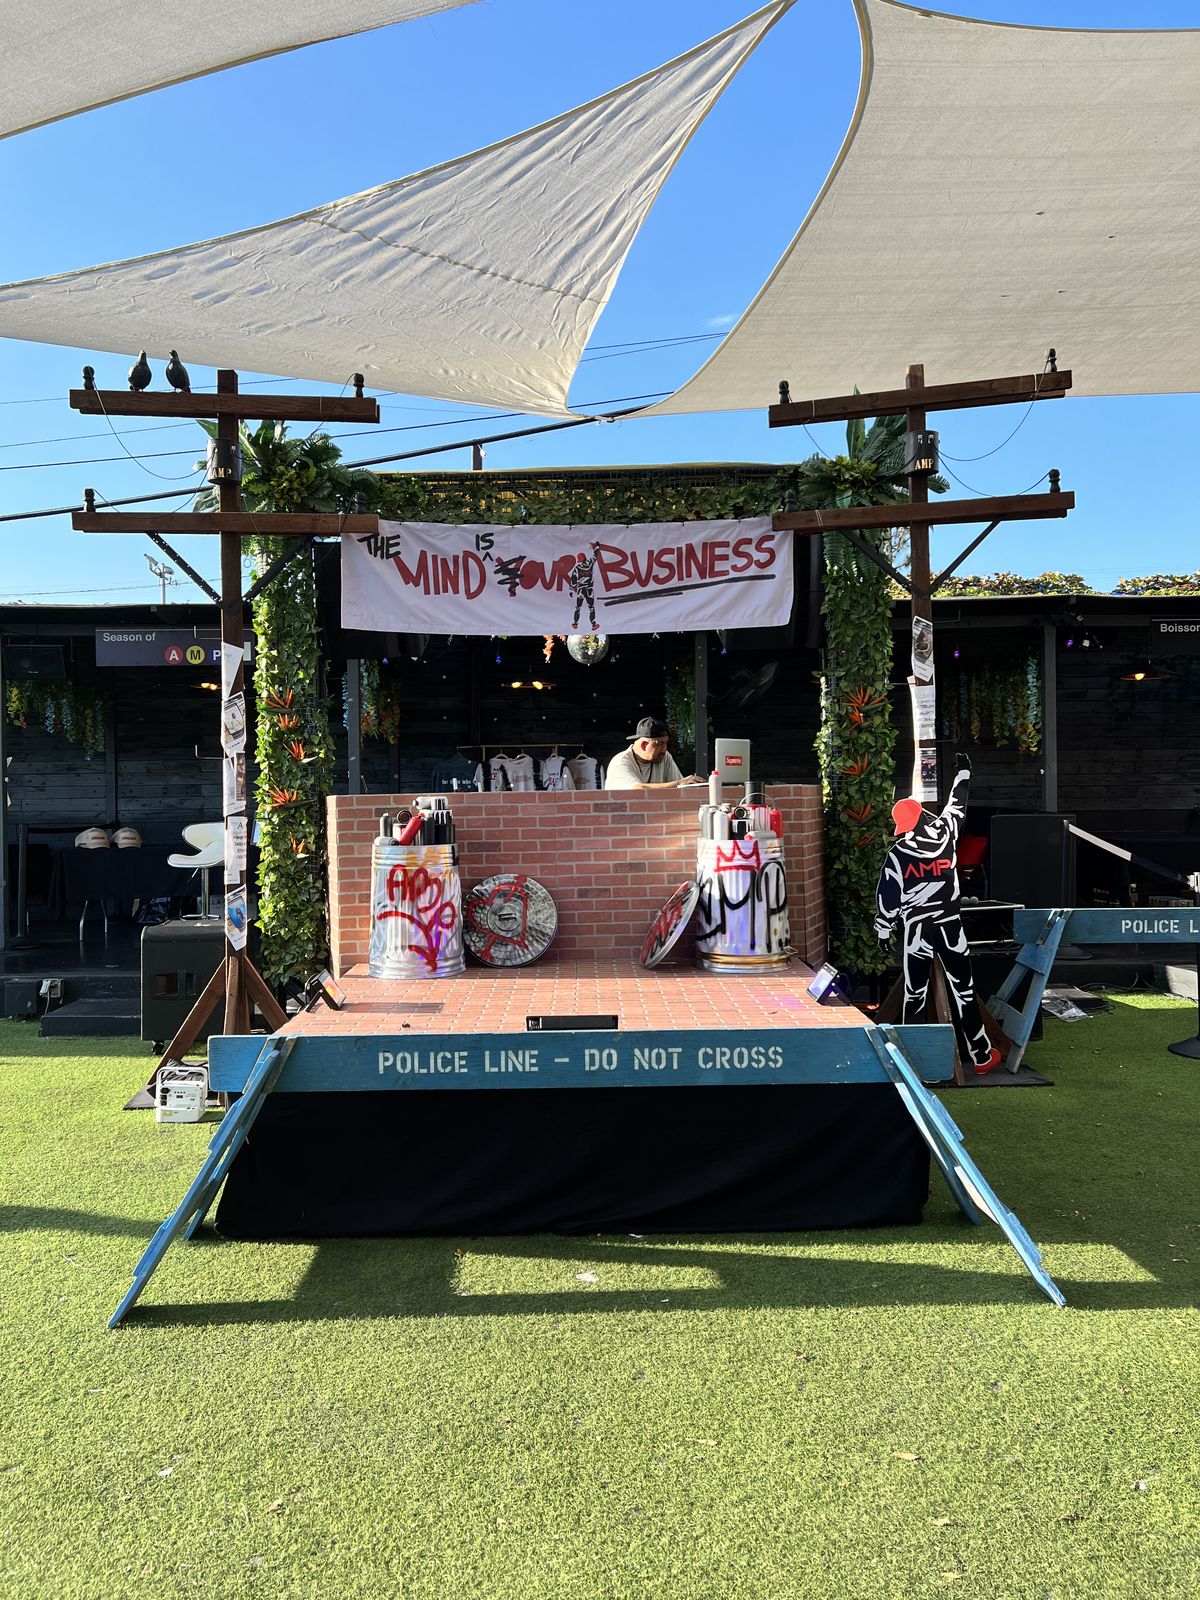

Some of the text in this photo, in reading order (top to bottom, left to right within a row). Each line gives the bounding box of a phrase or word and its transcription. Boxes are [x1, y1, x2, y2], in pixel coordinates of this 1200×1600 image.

[212, 467, 232, 478] AMP
[915, 458, 934, 470] AMP
[357, 533, 402, 561] THE
[475, 532, 495, 551] IS
[393, 549, 487, 600] MIND
[590, 534, 777, 592] BUSINESS
[102, 632, 156, 642] Season of
[904, 859, 952, 879] AMP
[1121, 919, 1180, 934] POLICE
[378, 1051, 468, 1074] POLICE
[484, 1050, 539, 1073] LINE
[584, 1048, 618, 1071] DO
[634, 1047, 682, 1070] NOT
[698, 1046, 783, 1069] CROSS
